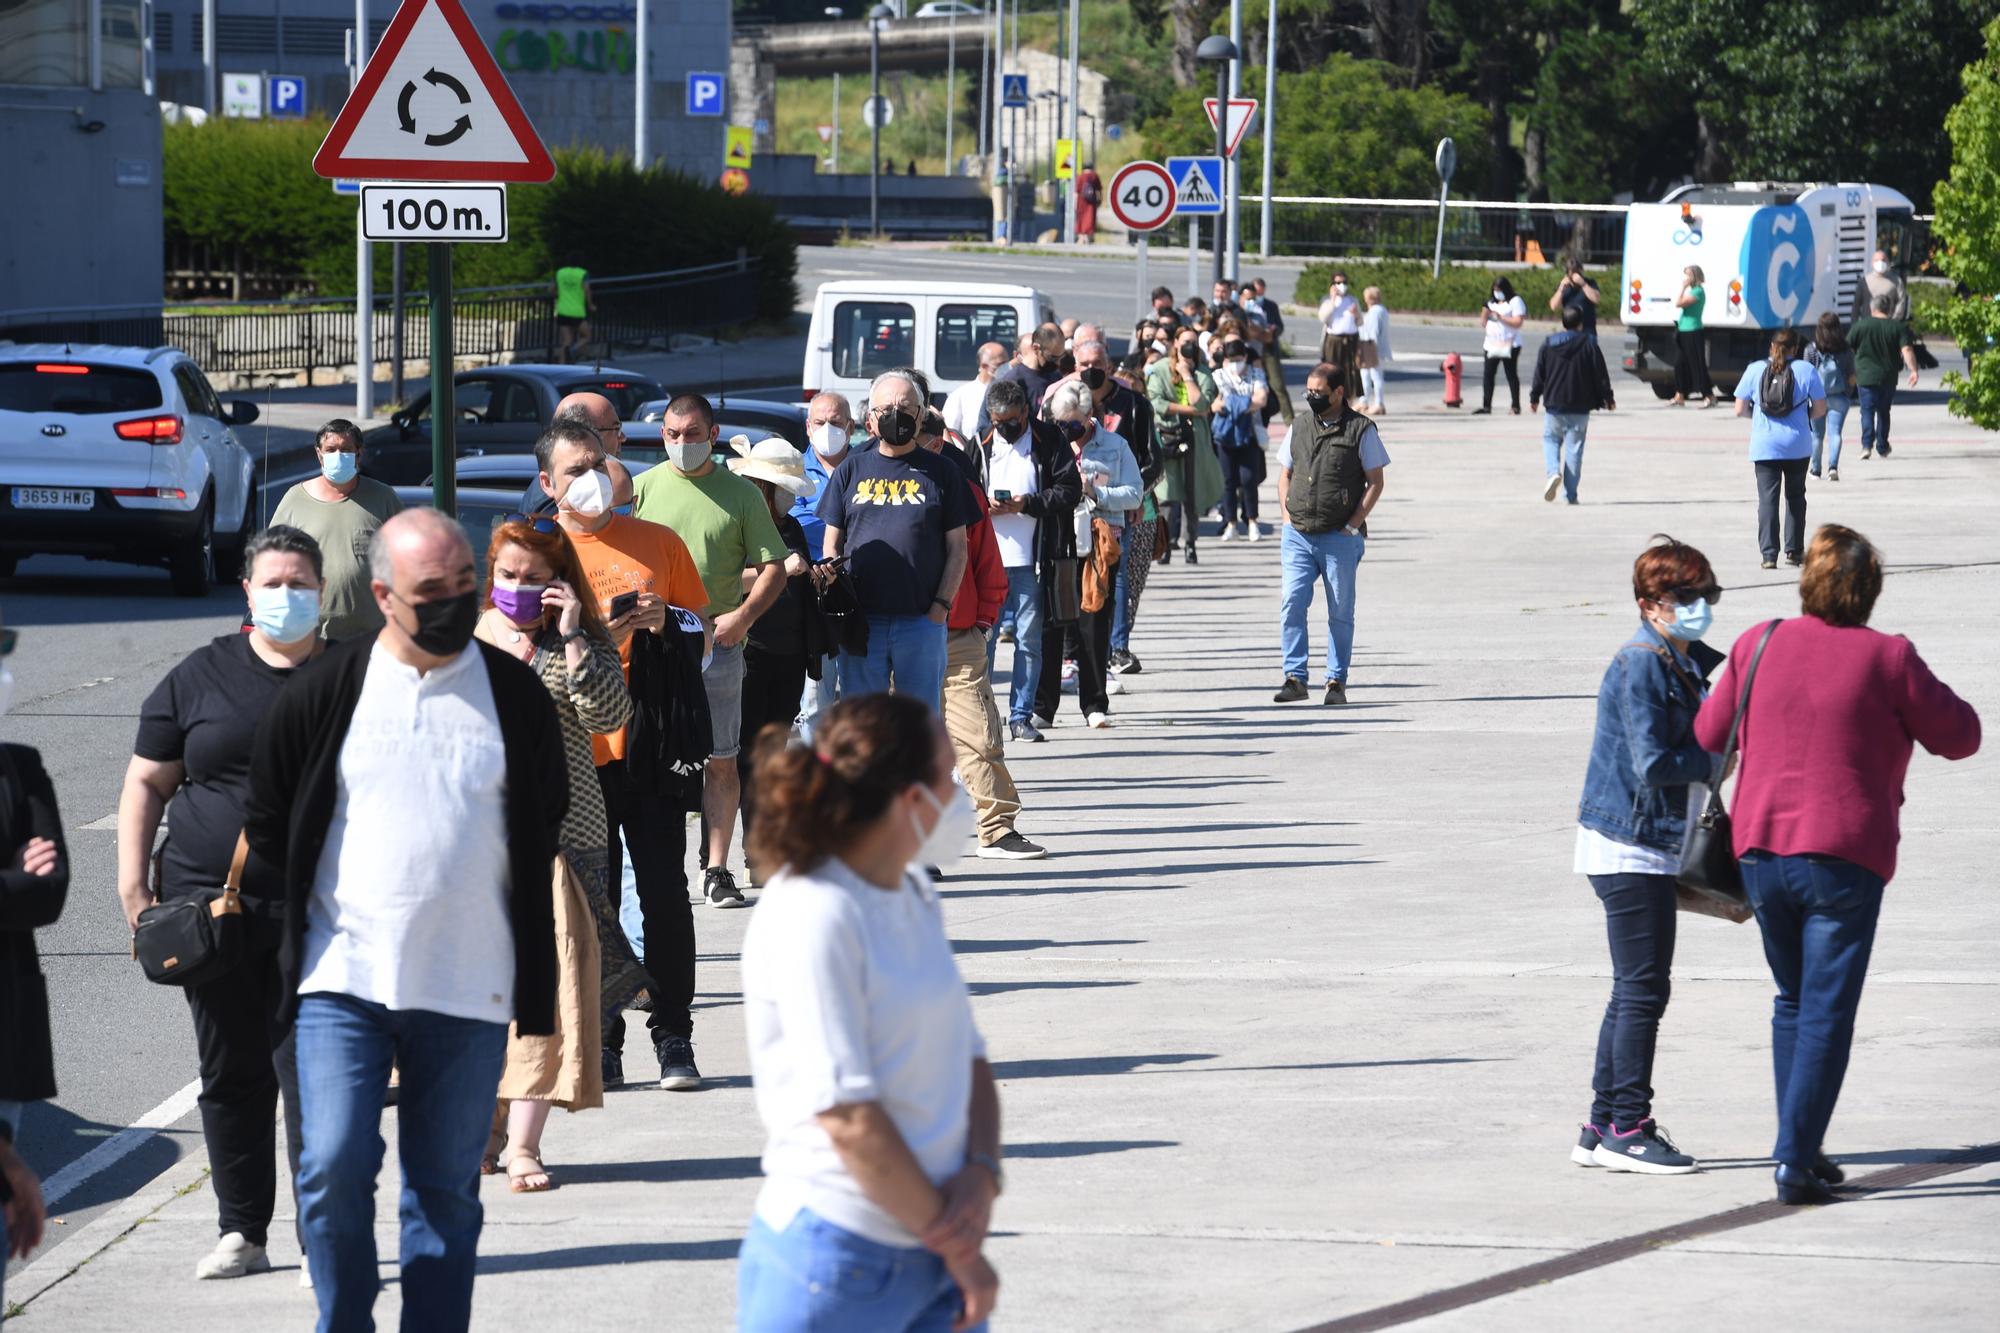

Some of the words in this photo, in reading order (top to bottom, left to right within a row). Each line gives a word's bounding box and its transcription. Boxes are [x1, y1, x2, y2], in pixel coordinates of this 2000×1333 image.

[278, 80, 298, 109] P
[694, 80, 717, 108] P
[1123, 185, 1164, 208] 40
[22, 490, 59, 504] 3659
[63, 491, 91, 505] HWG
